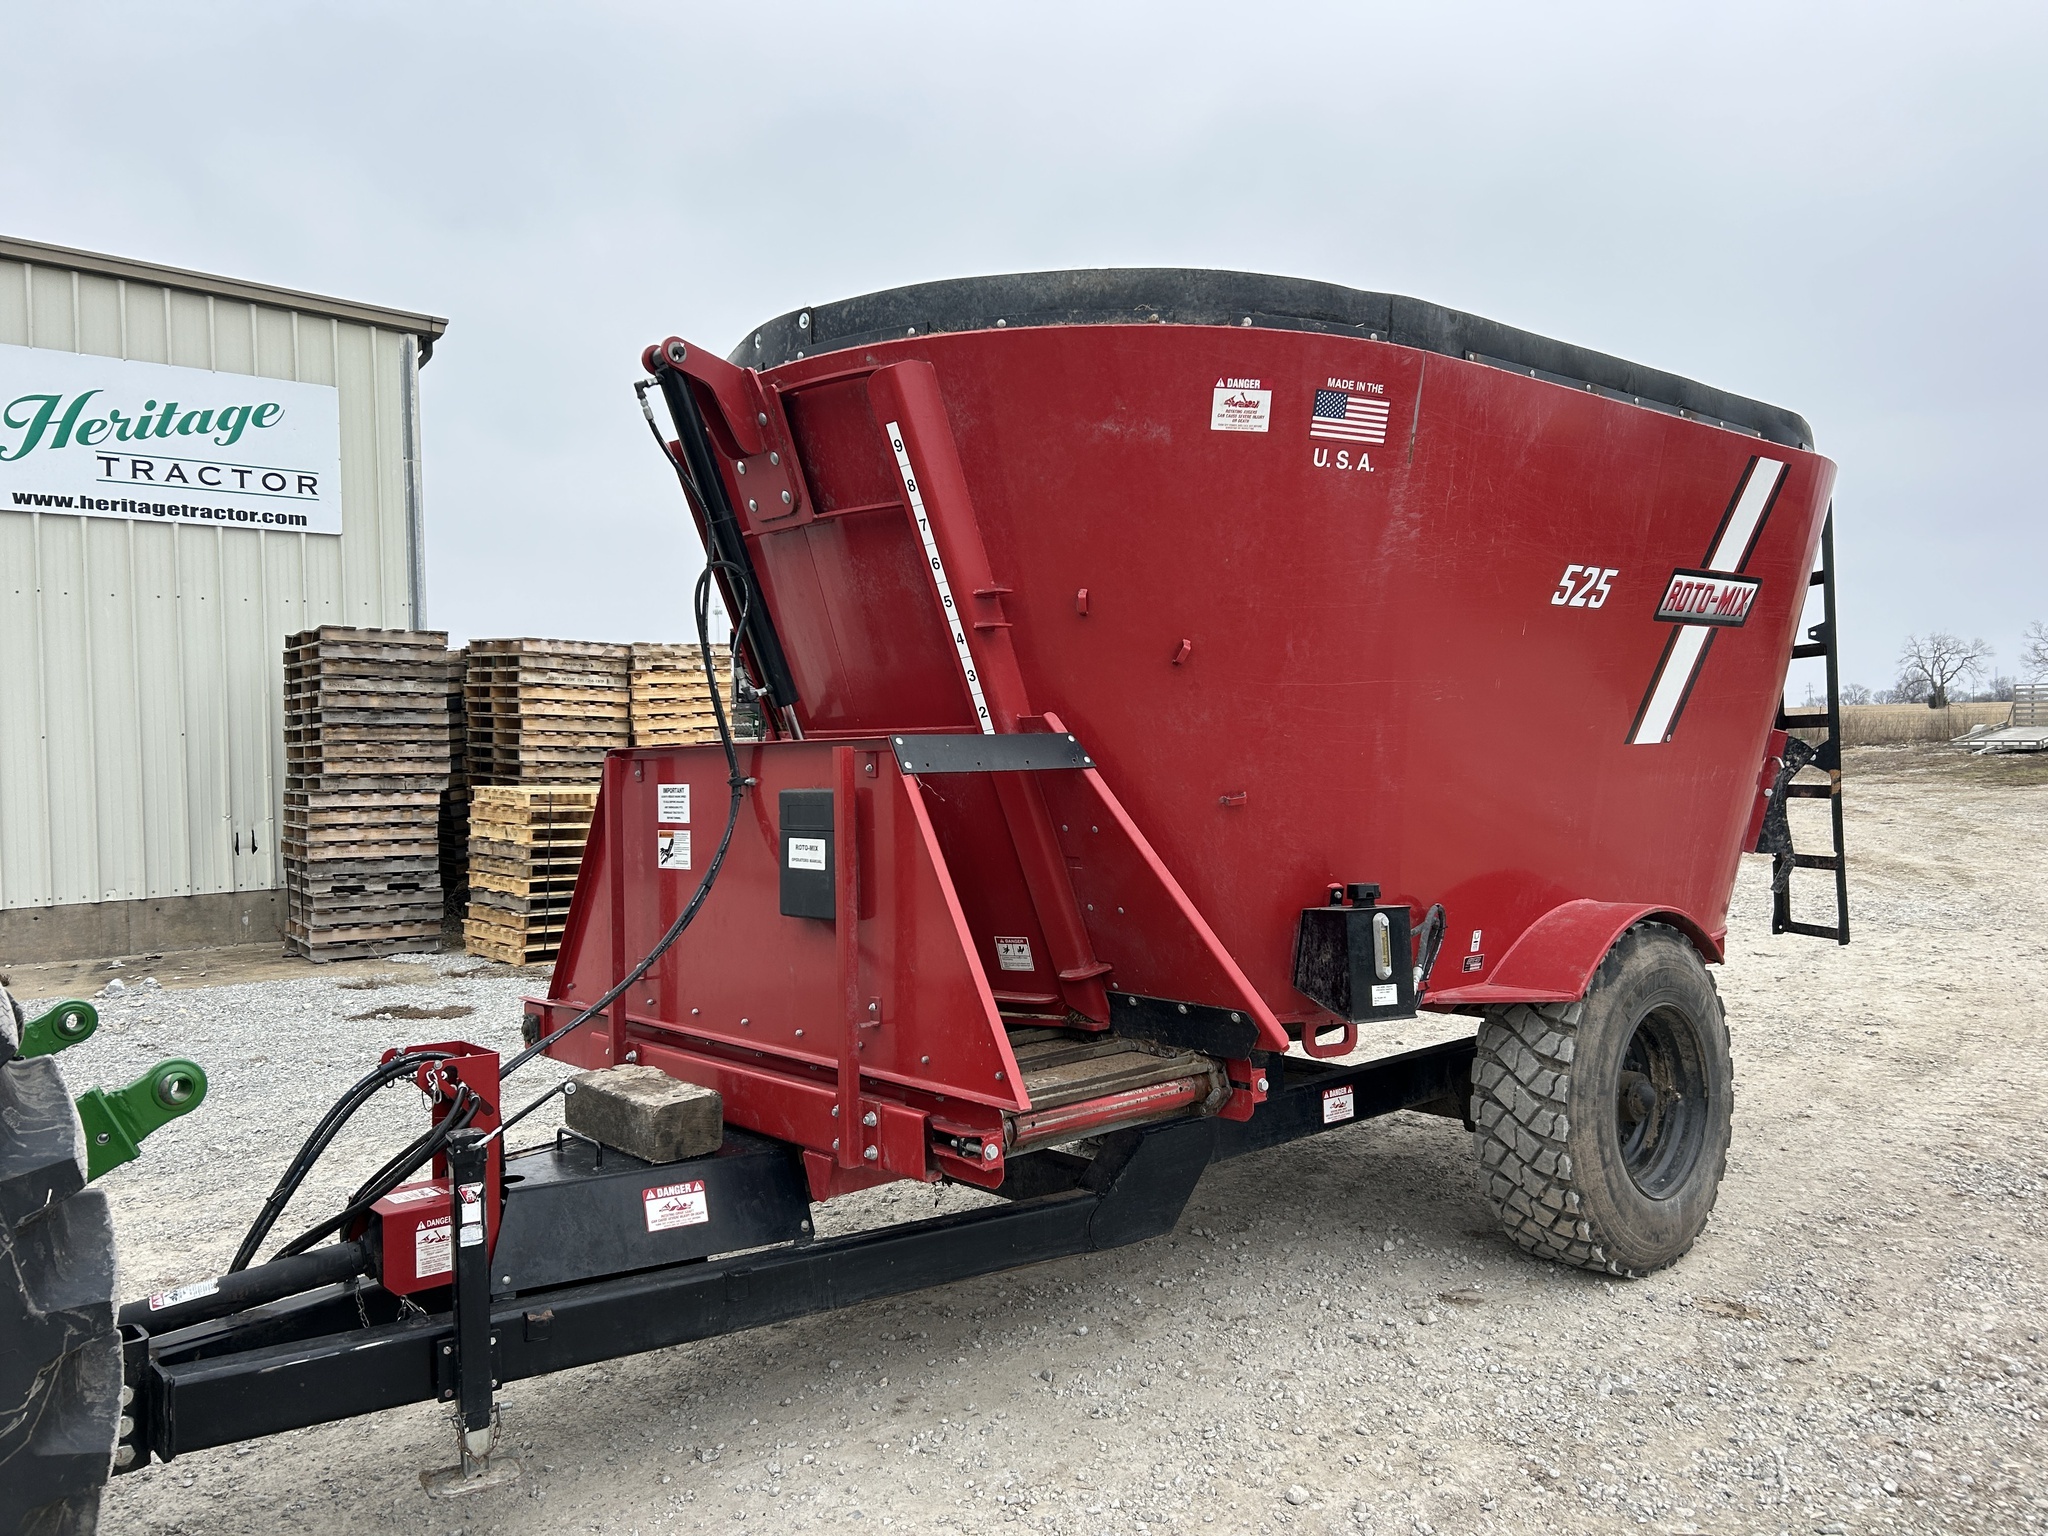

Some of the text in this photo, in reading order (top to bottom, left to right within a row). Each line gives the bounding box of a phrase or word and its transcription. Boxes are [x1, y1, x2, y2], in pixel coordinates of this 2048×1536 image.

[1227, 378, 1260, 389] DANGER
[1327, 377, 1384, 394] MADE IN THE
[0, 389, 285, 461] Heritage
[893, 438, 903, 452] 9
[96, 454, 319, 496] TRACTOR
[906, 478, 916, 492] 8
[12, 491, 308, 526] www.heritagetractor.com
[918, 518, 927, 531] 7
[931, 557, 941, 570] 6
[1550, 563, 1620, 609] 525
[943, 594, 953, 608] 5
[1662, 579, 1754, 618] ROTO-MIX
[956, 632, 965, 645] 4
[967, 669, 976, 682] 3
[978, 706, 988, 719] 2
[795, 843, 819, 852] ROTO-MIX
[1330, 1087, 1347, 1098] DANGER
[656, 1183, 691, 1197] DANGER
